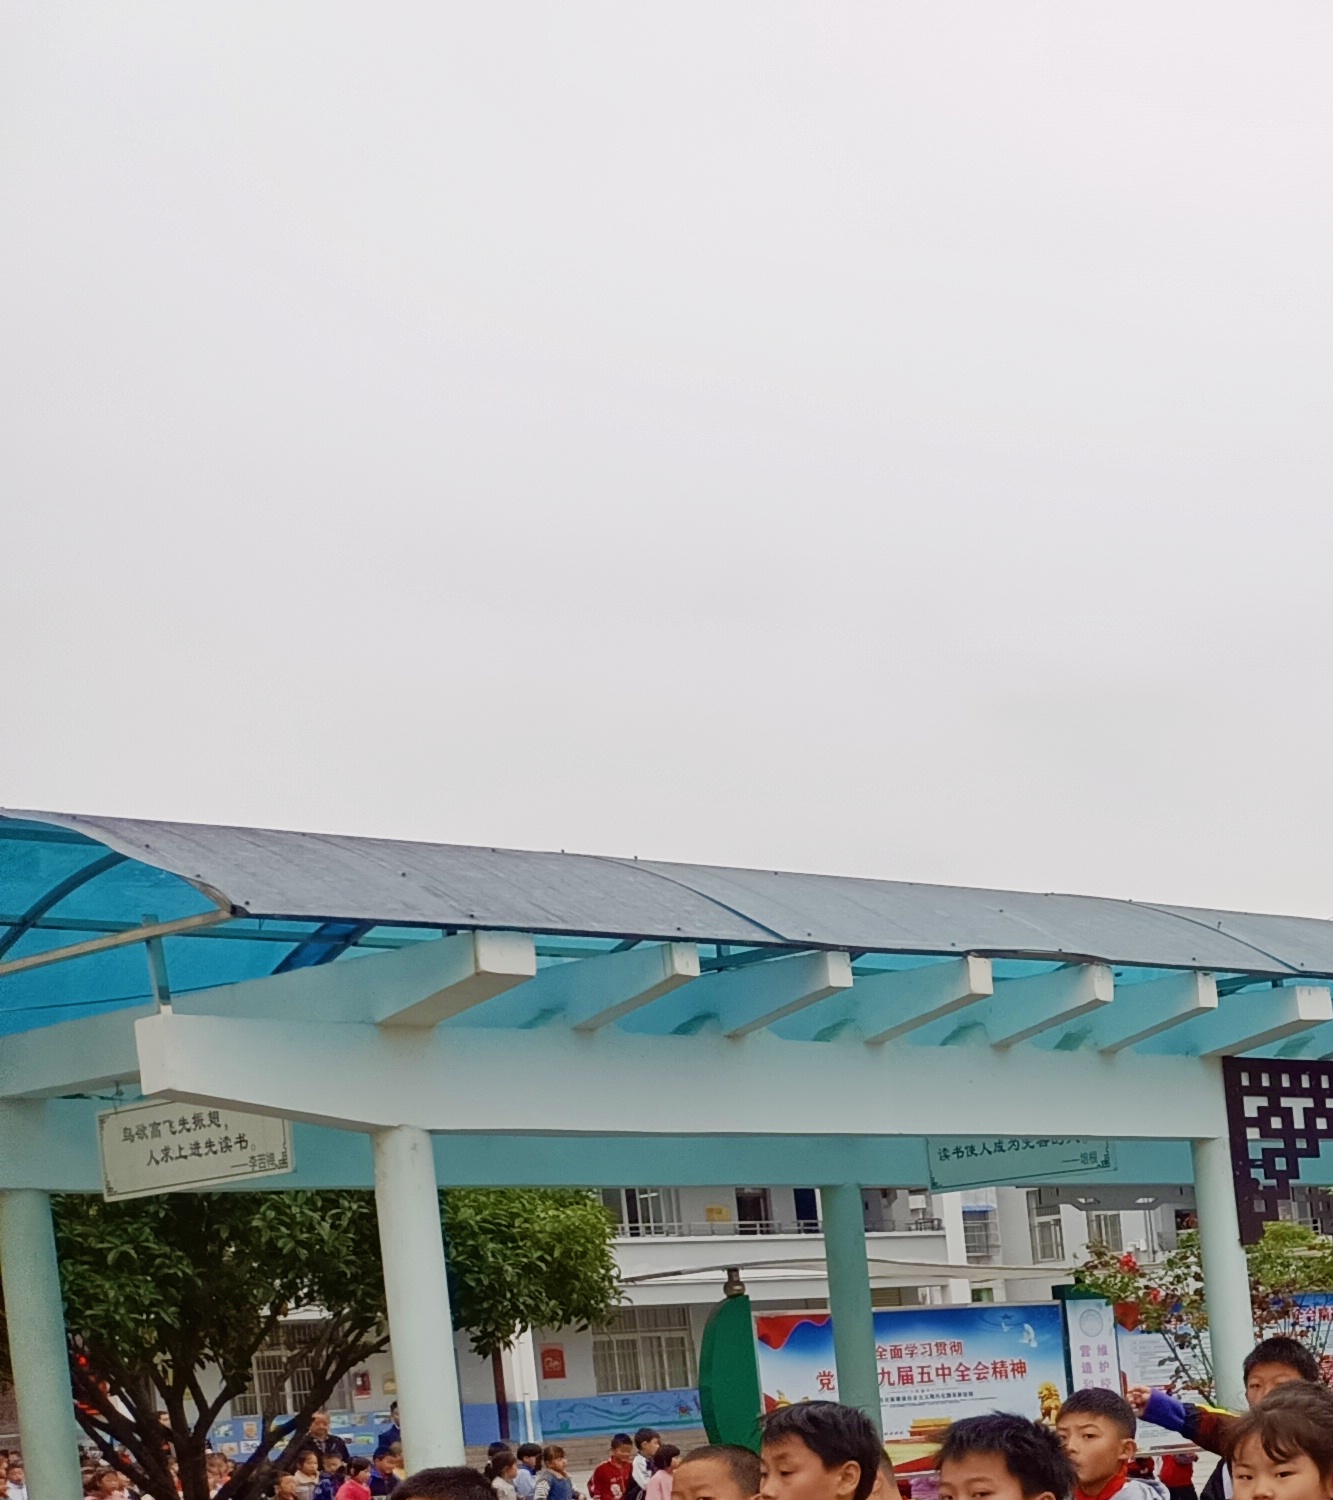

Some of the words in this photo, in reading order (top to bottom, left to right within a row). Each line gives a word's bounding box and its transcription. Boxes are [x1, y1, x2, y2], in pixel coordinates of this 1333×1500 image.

[875, 1340, 964, 1360] 全面学习贯彻
[816, 1358, 1027, 1392] 党九届五中全会精神
